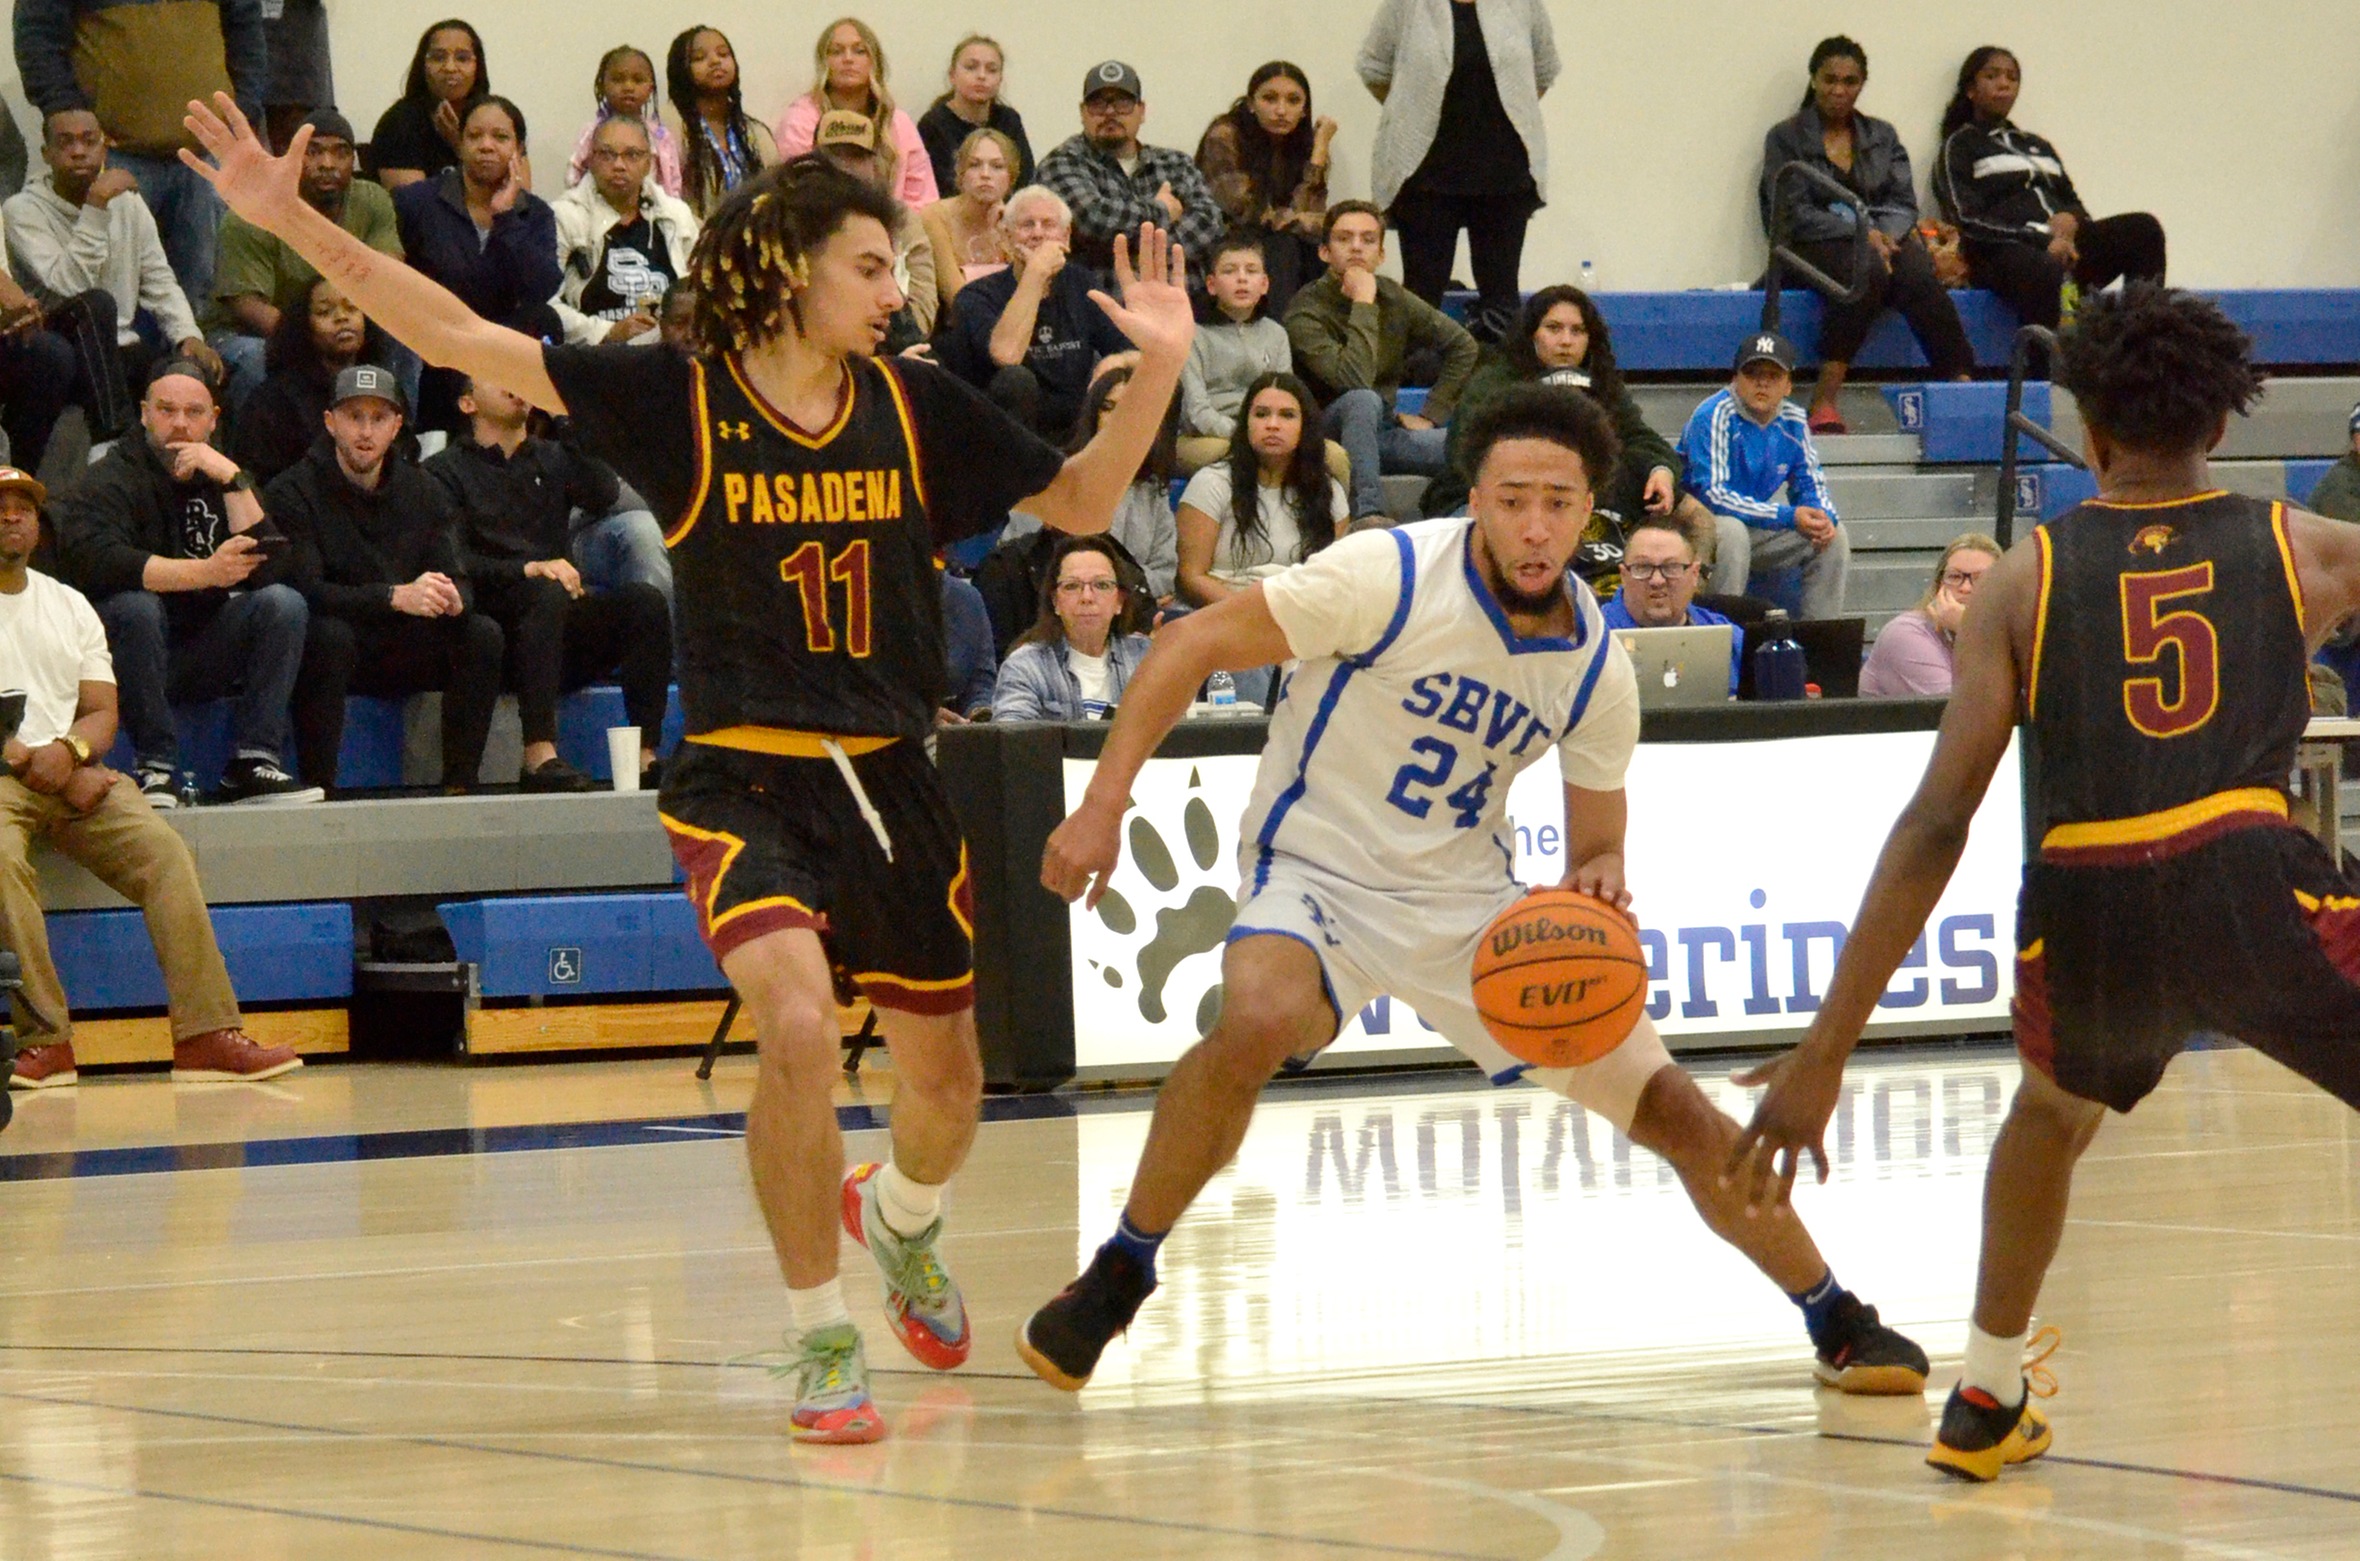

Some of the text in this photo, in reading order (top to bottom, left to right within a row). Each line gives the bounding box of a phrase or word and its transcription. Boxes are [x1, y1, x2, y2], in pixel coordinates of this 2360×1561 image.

[723, 469, 901, 524] PASADENA
[1584, 542, 1624, 562] 30
[779, 538, 871, 659] 11
[2119, 560, 2219, 739] 5
[1385, 736, 1498, 829] 24
[1508, 815, 1560, 856] he
[1492, 917, 1607, 957] Wilson
